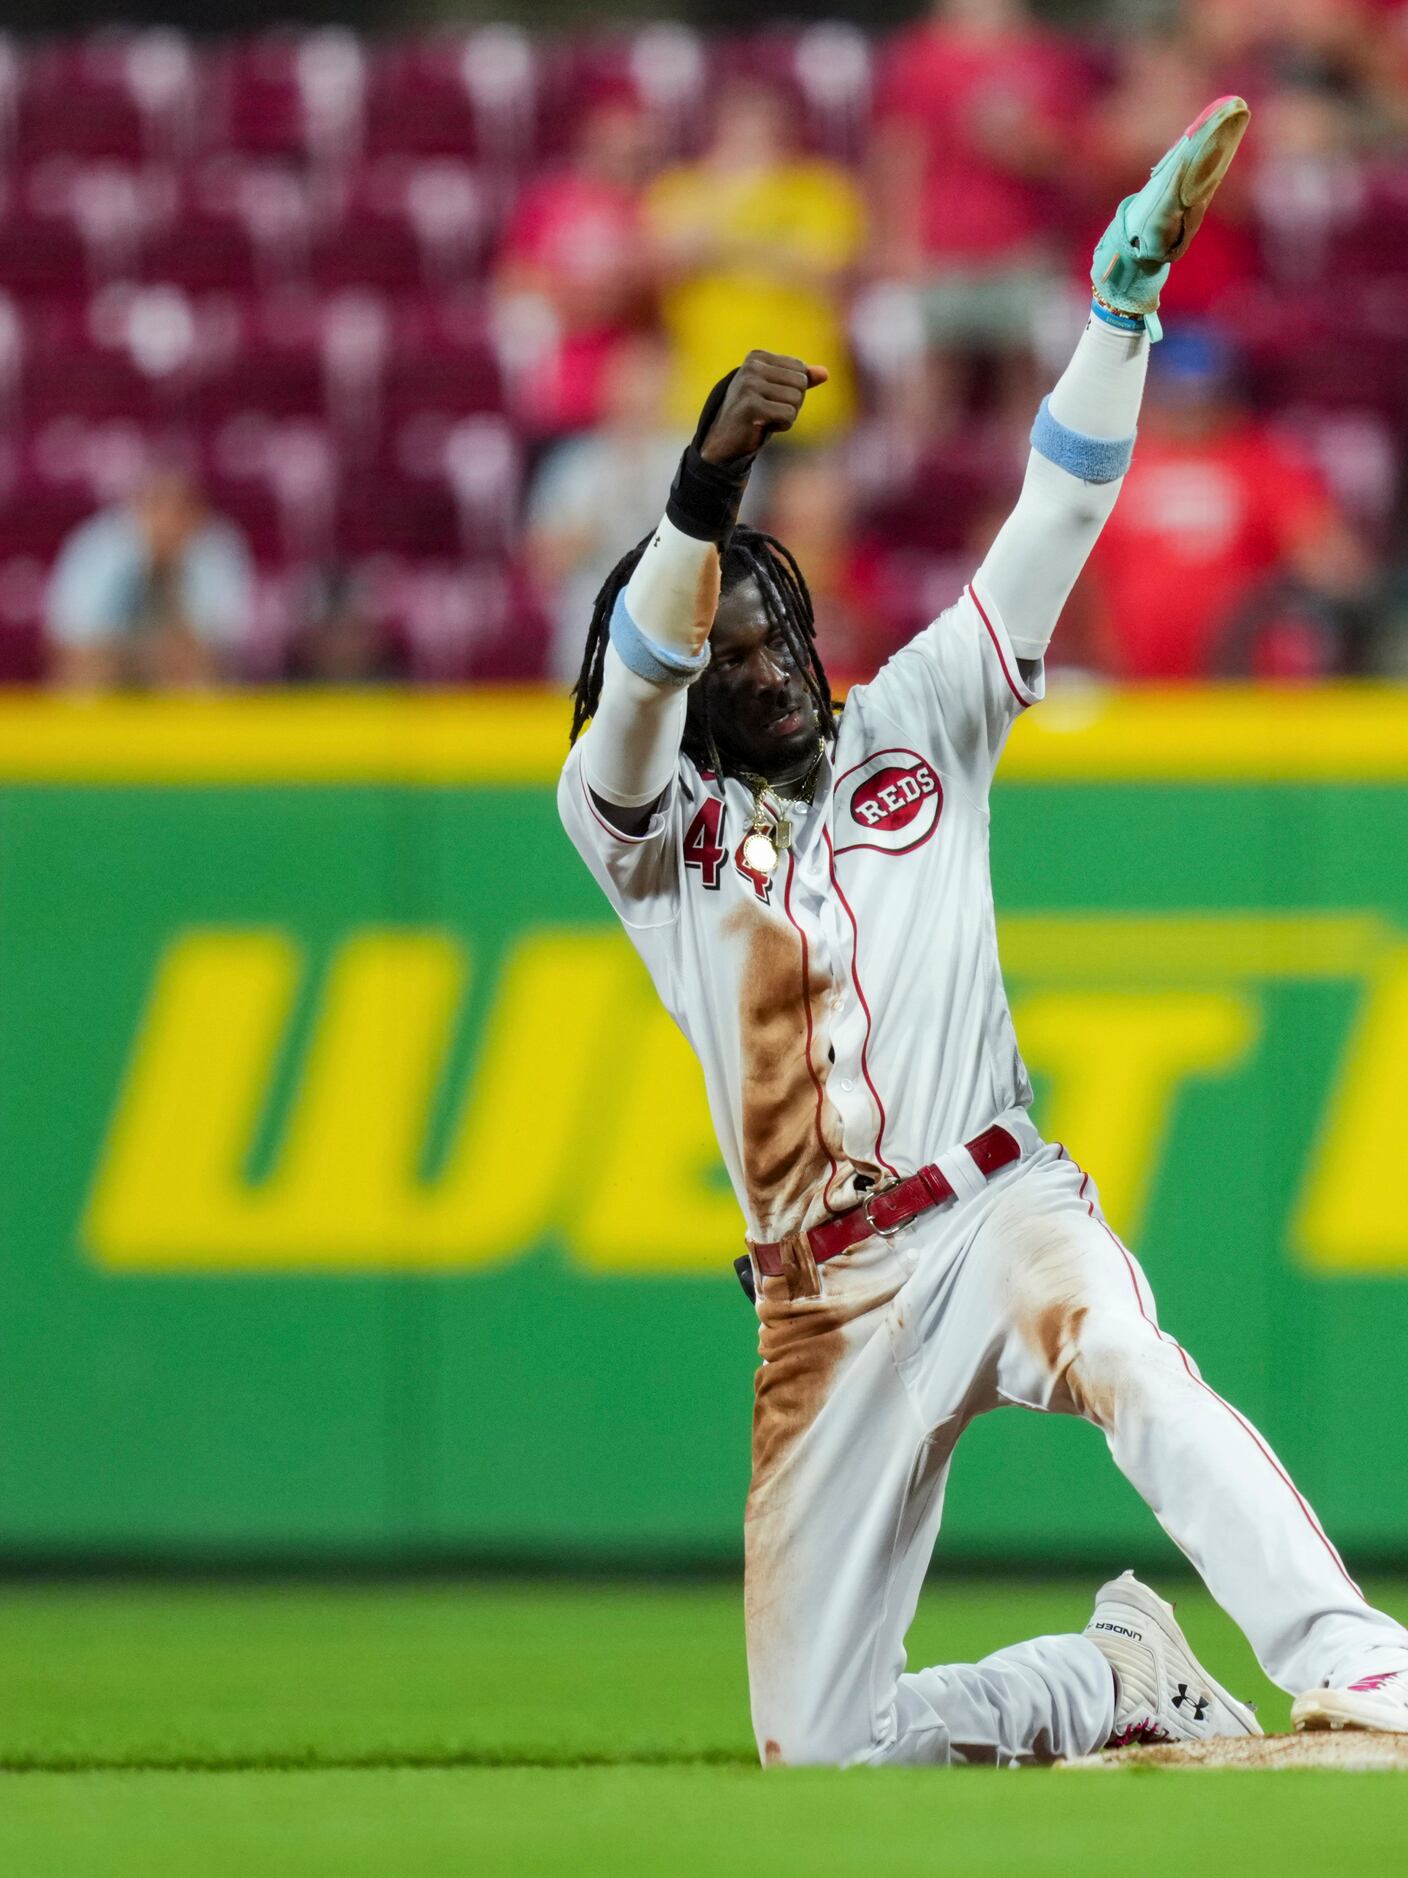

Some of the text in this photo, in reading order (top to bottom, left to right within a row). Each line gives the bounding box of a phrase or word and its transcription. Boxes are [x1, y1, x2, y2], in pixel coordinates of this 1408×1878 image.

[855, 766, 936, 826] REDS
[82, 922, 1260, 1272] WET
[1095, 1622, 1143, 1642] UNDER
